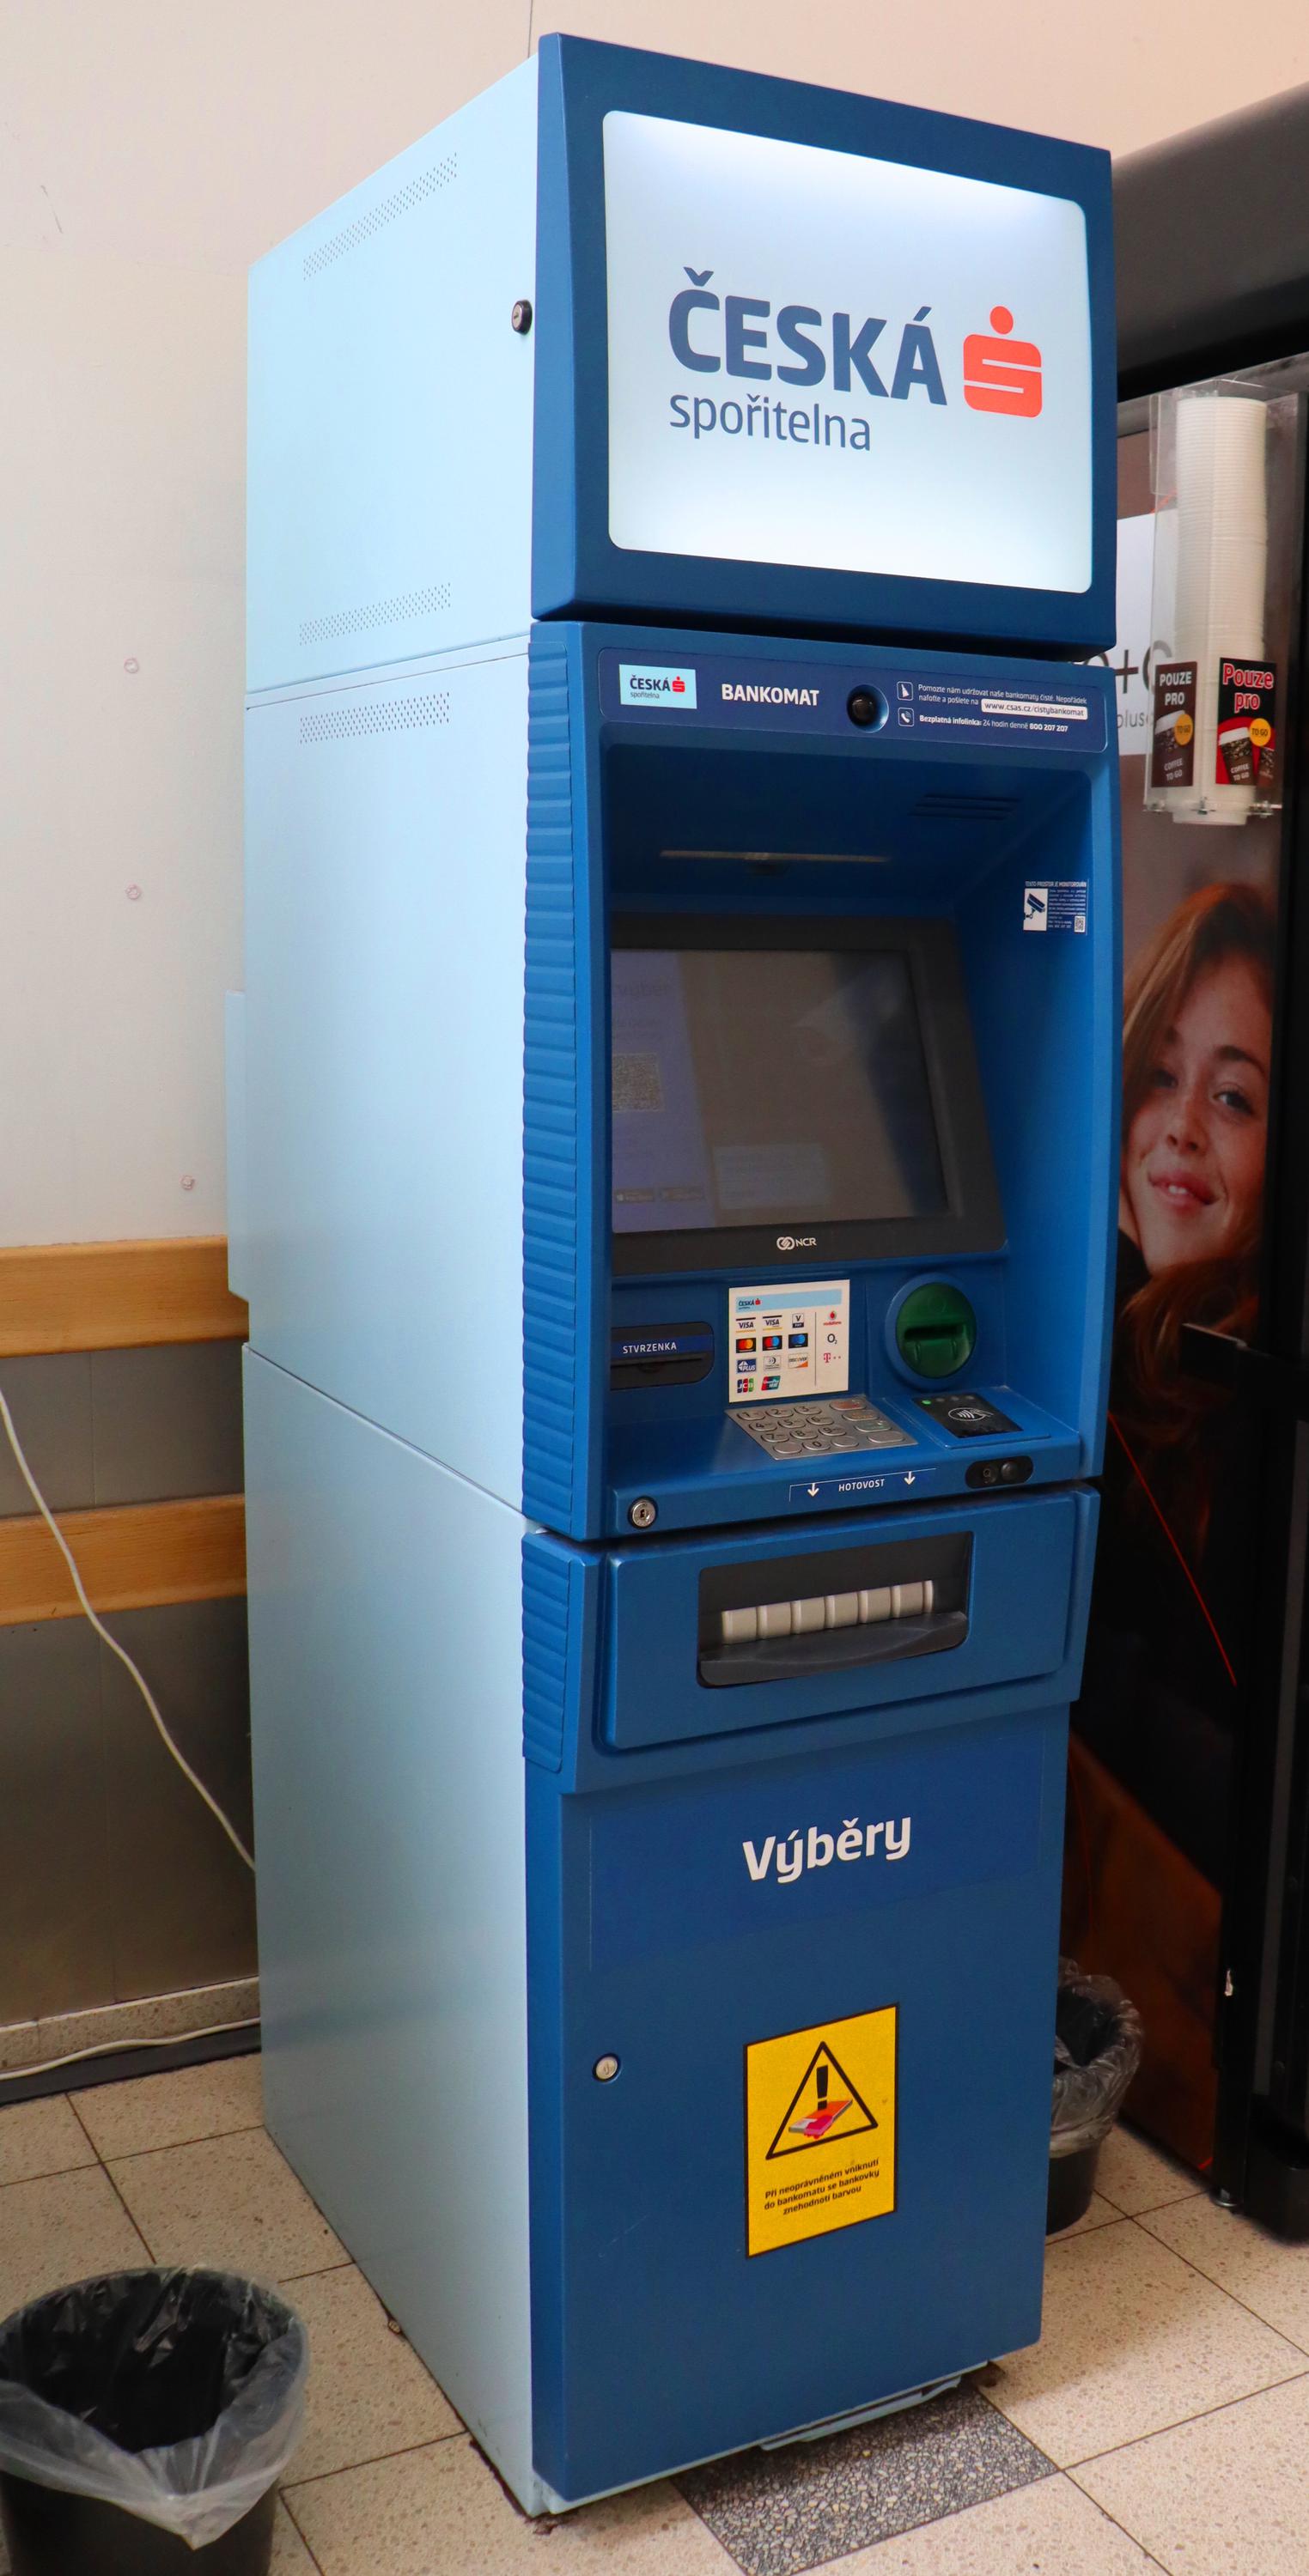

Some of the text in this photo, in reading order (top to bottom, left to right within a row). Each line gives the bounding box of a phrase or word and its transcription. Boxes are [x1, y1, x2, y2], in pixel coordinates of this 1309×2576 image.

[668, 266, 947, 406] ČESKÁ
[669, 393, 870, 451] spořitelna
[630, 675, 671, 692] ČESKÁ
[1160, 671, 1192, 686] POUZE
[1222, 662, 1274, 690] Pouze
[721, 683, 819, 707] BANKOMAT
[918, 683, 946, 695] Pomozte
[962, 688, 989, 697] udržovat
[989, 690, 1004, 698] naše
[1005, 691, 1039, 702] bankomaty
[1056, 695, 1087, 705] Nepořádek
[1165, 691, 1185, 706] PRO
[1233, 691, 1260, 714] pro
[984, 702, 1084, 718] www.csas.cz/cistybankomat
[919, 714, 952, 725] Bezplatná
[953, 717, 982, 726] infolinka:
[1009, 721, 1029, 730] denně
[1029, 722, 1043, 731] 800
[1044, 724, 1056, 732] 207
[1056, 724, 1069, 732] 207
[796, 1236, 817, 1248] NCR
[623, 1342, 677, 1354] STVRZENKA
[838, 1479, 885, 1492] HOTOVOST
[742, 1816, 911, 1884] Výběry
[765, 2157, 879, 2199] Při neoprávněném vniknutí
[764, 2170, 880, 2210] do bankomatu se bankovky
[783, 2185, 862, 2215] znehodnotí barvou
